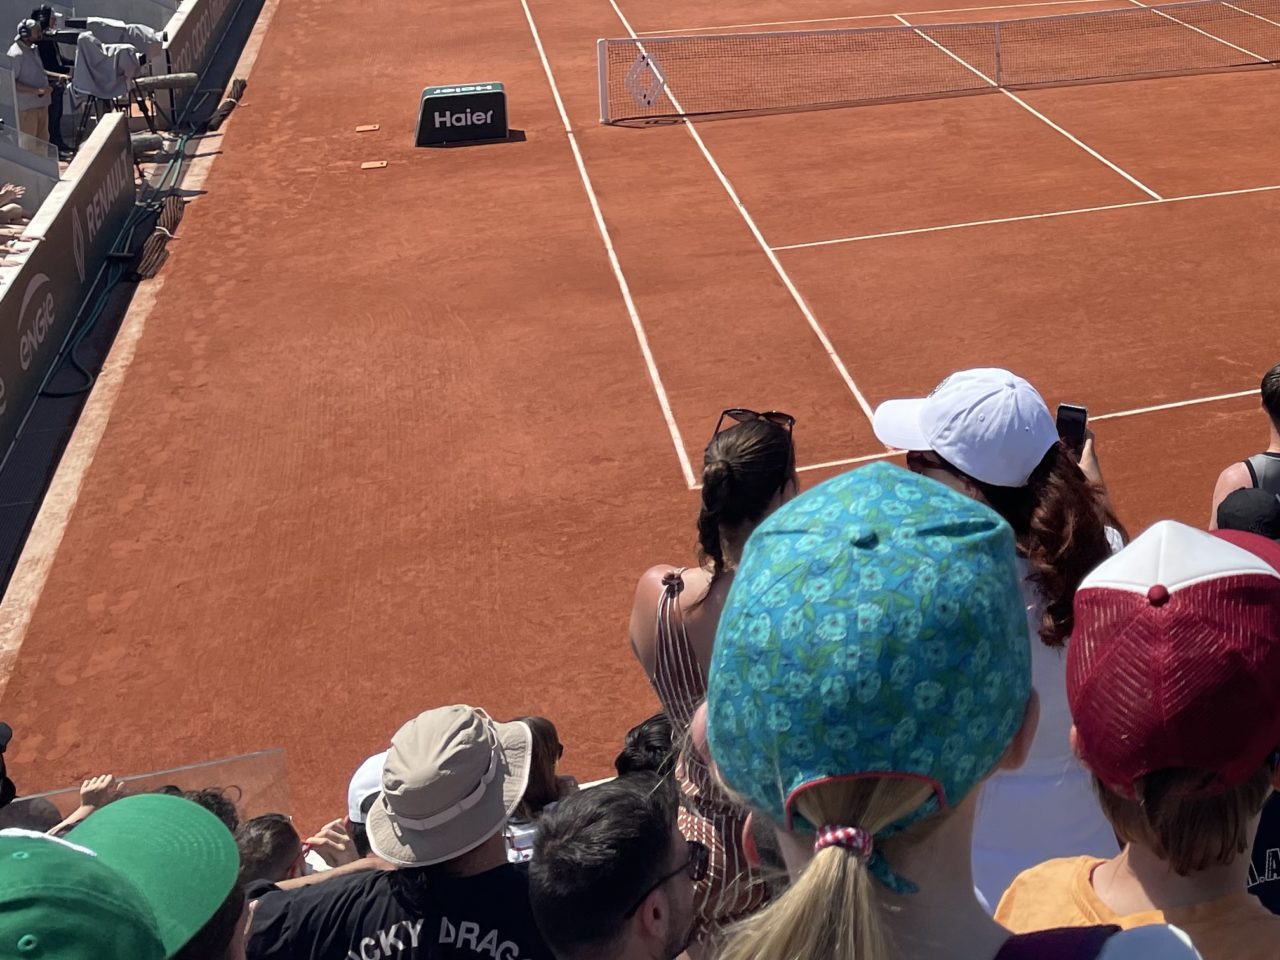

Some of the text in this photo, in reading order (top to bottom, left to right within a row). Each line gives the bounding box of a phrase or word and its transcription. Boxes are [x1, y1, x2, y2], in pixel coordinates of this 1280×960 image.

[434, 108, 494, 128] Haier
[85, 147, 130, 243] RENAULT
[438, 916, 534, 959] DRAG
